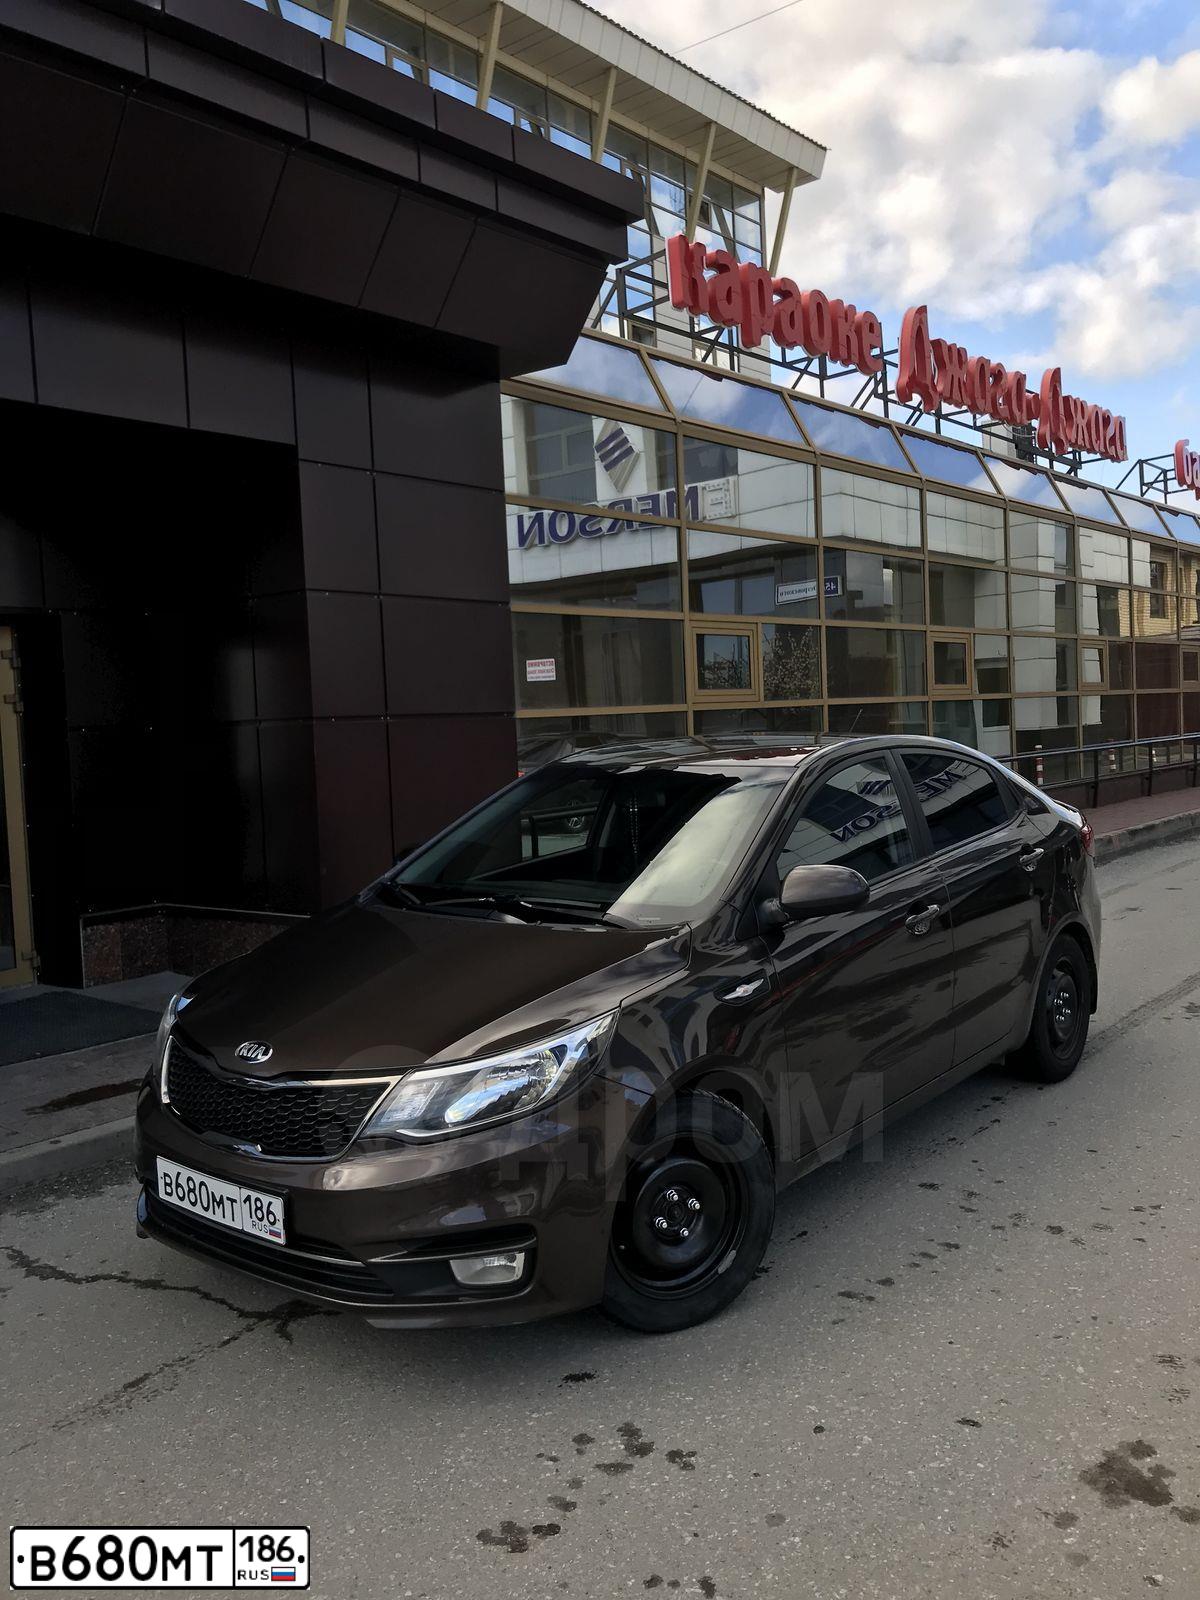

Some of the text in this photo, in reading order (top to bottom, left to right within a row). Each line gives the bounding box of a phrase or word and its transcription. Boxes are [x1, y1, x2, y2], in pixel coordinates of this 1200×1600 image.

[238, 1042, 268, 1061] KIA
[163, 1171, 277, 1226] В680МТ 186
[251, 1220, 269, 1234] RUS
